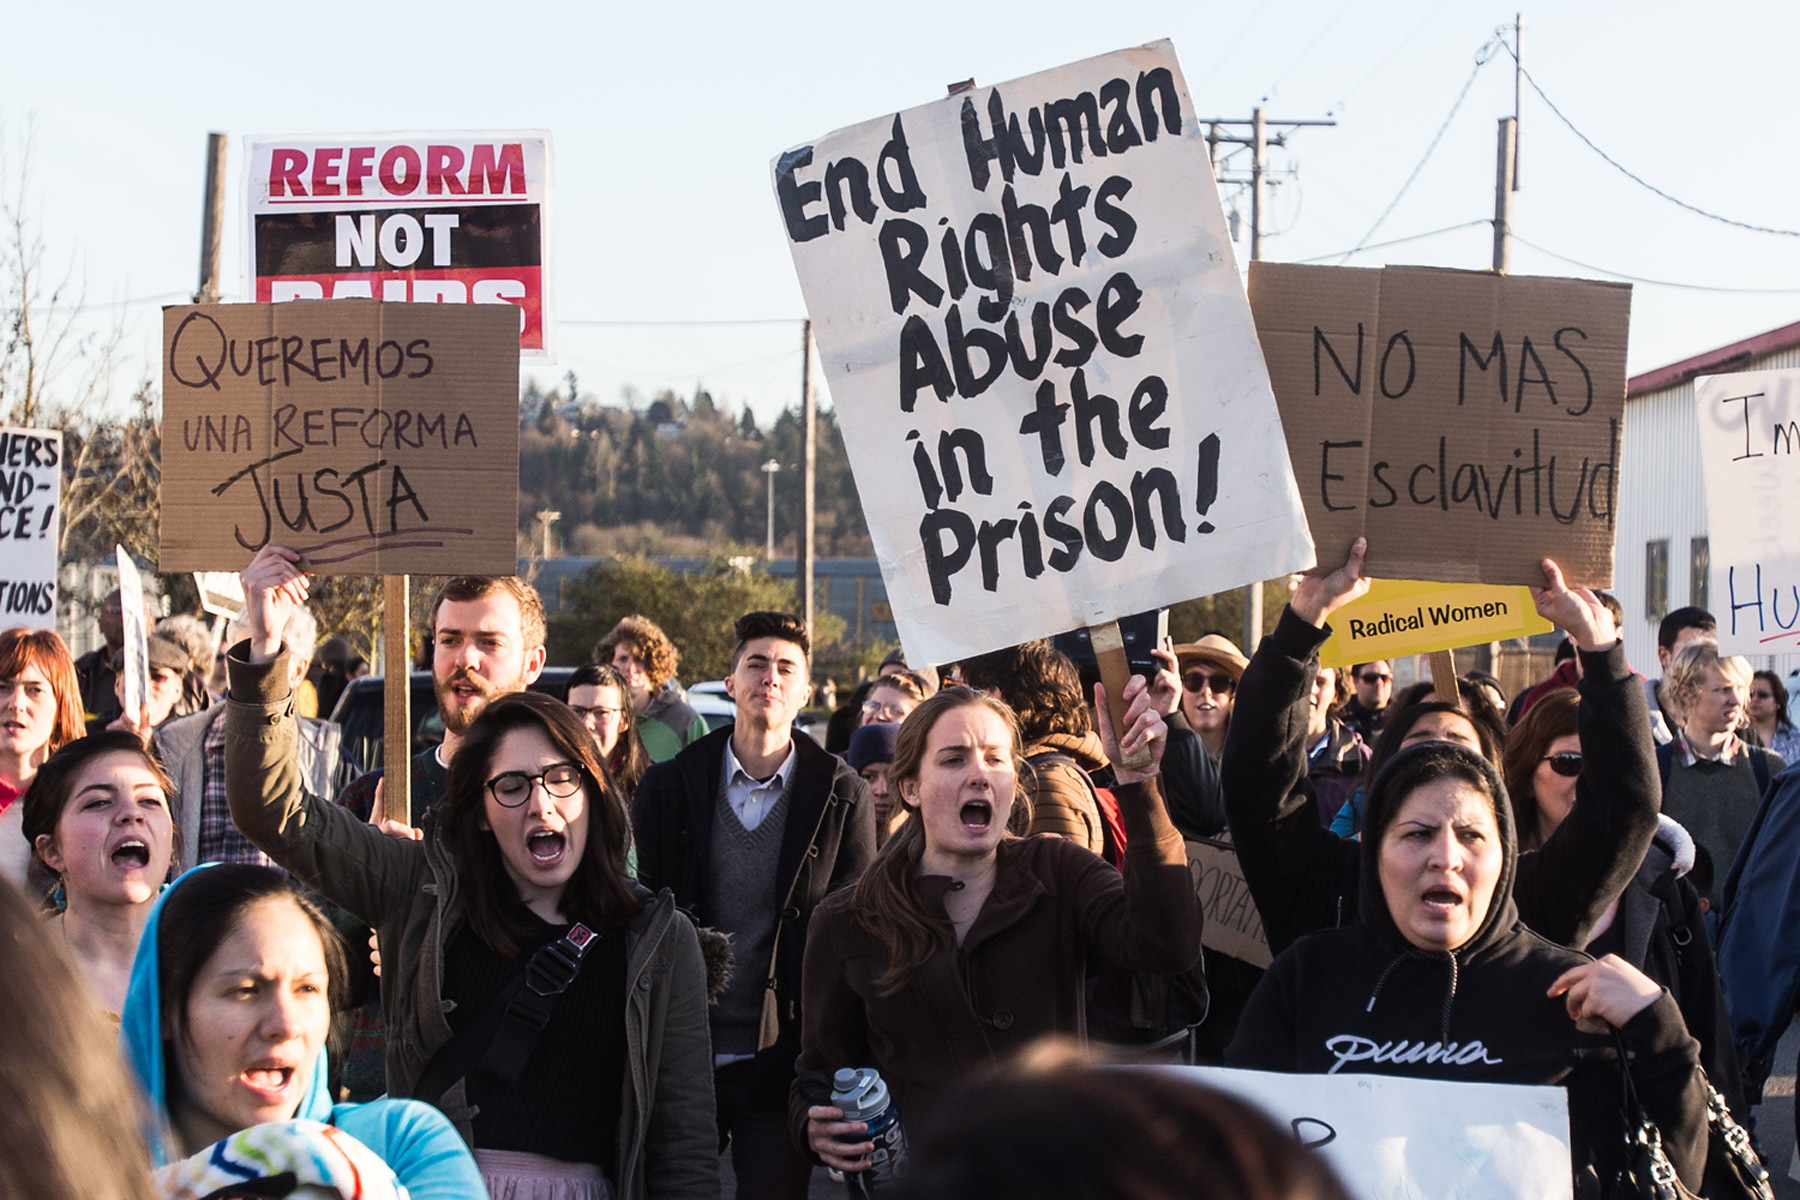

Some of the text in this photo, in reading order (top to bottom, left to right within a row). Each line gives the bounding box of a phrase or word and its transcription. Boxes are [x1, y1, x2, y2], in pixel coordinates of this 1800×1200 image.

[269, 144, 526, 196] REFORM
[776, 67, 1182, 242] End Human
[335, 214, 460, 266] NOT
[878, 172, 1137, 323] Rights
[170, 312, 433, 390] QUEREMOS
[900, 272, 1144, 412] Abuse
[1314, 323, 1593, 415] NO MAS
[184, 404, 477, 452] UNA REFORMA
[906, 367, 1171, 509] in the
[211, 448, 429, 551] JUSTA
[1349, 601, 1507, 640] Radical Women
